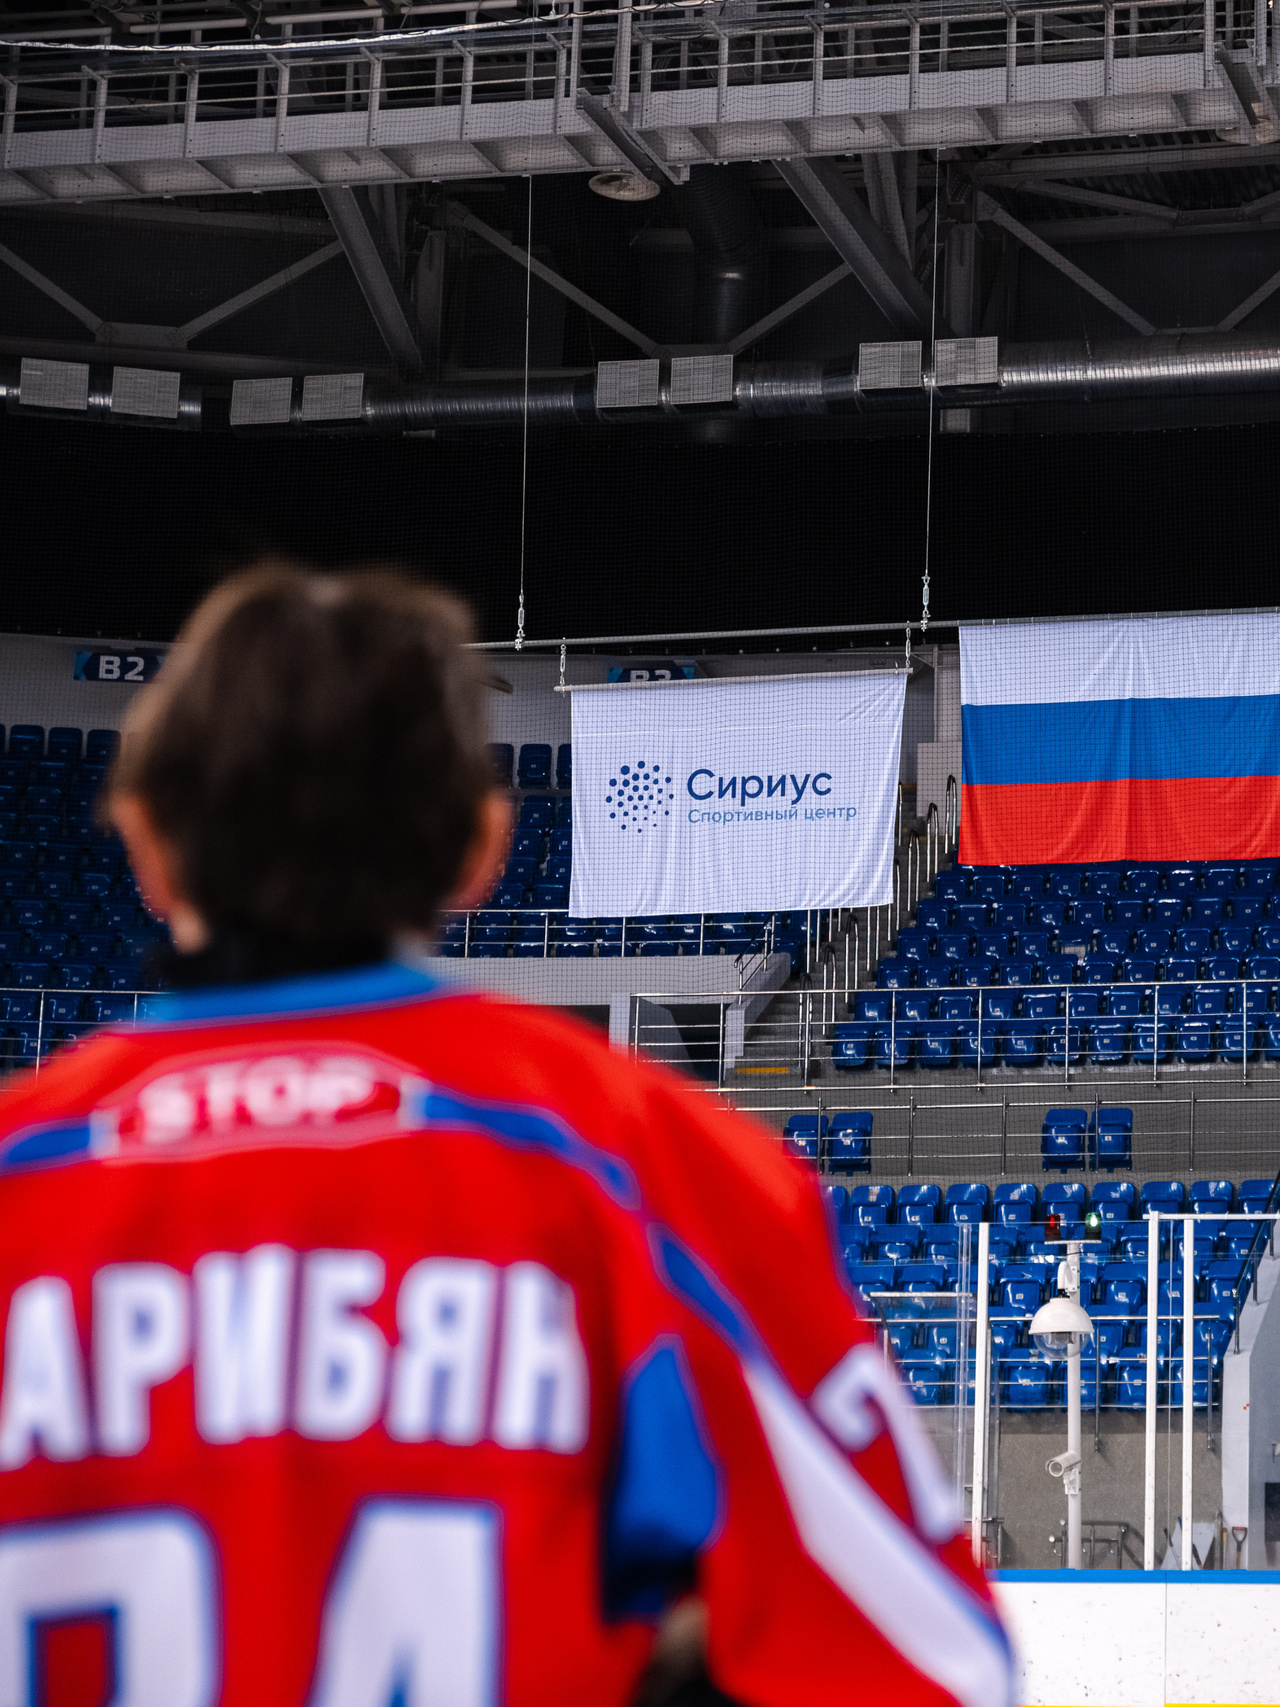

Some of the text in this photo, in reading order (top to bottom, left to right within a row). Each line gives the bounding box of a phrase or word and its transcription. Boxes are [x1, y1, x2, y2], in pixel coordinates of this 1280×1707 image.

[98, 655, 145, 681] B2
[687, 768, 832, 807] Сириус
[688, 806, 857, 825] Спортивный центр
[139, 1055, 378, 1145] STOP
